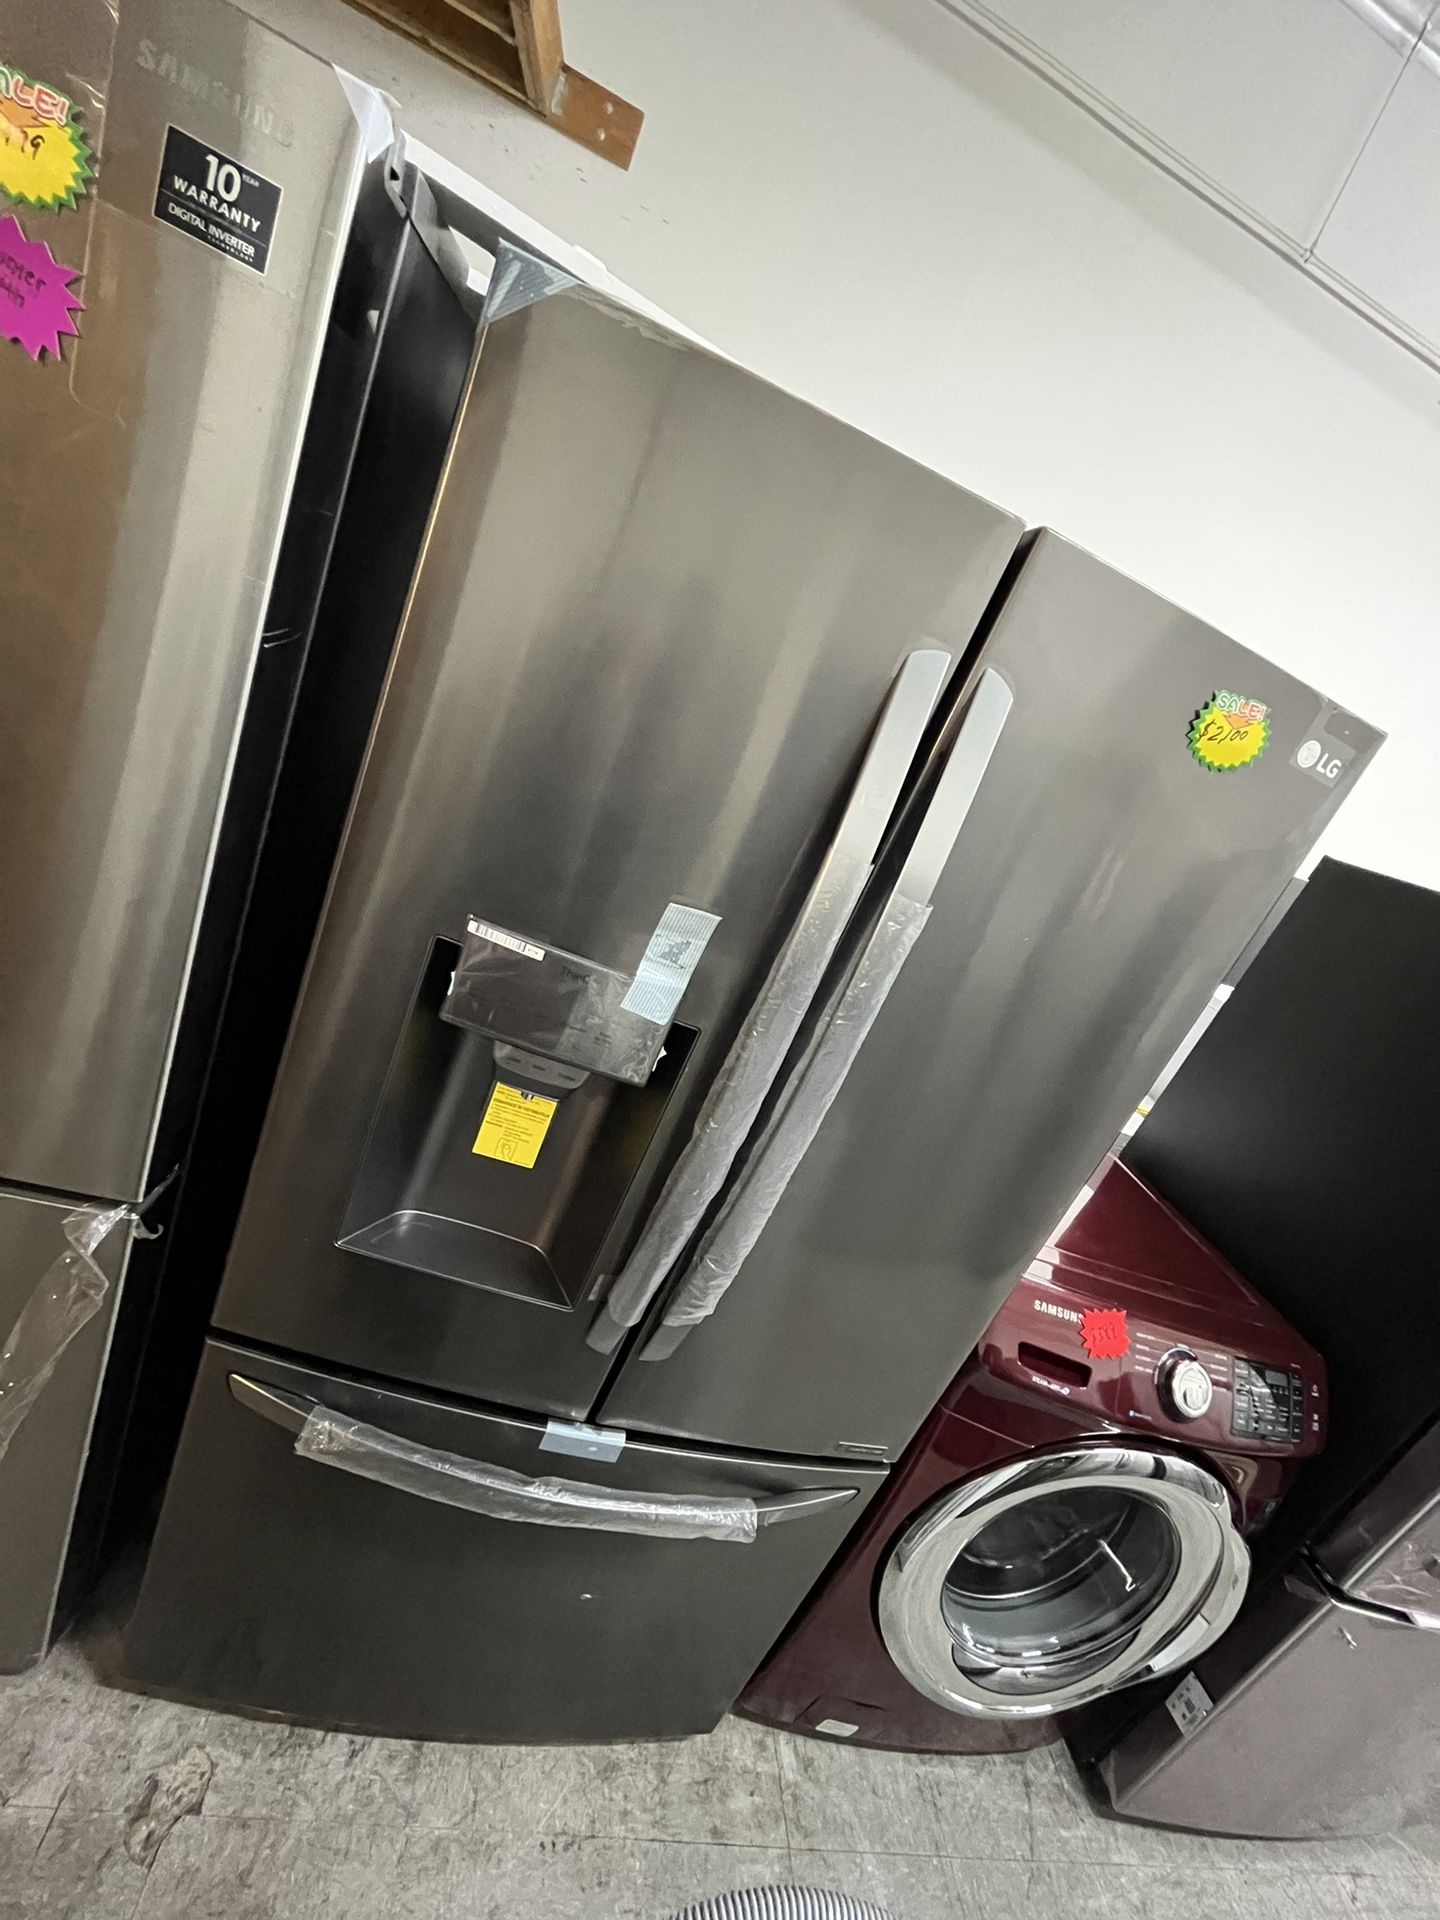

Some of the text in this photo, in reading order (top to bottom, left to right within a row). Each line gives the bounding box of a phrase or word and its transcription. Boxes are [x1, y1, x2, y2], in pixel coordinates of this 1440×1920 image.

[205, 153, 242, 203] 10
[173, 175, 262, 233] WARRANTY
[168, 201, 256, 258] DIGITAL INVERTER
[1216, 693, 1267, 722] SALE!
[1316, 753, 1343, 779] LG
